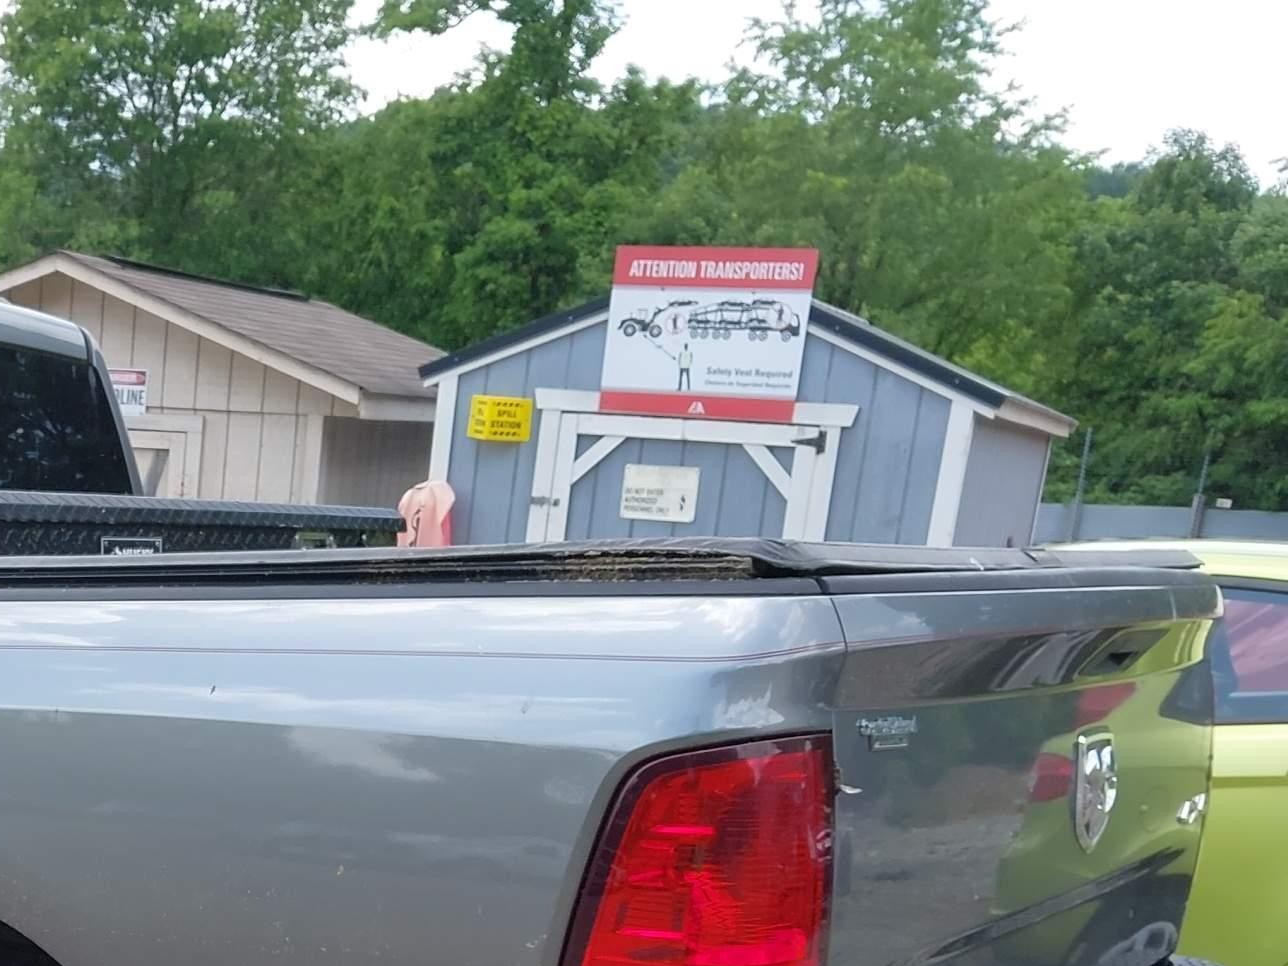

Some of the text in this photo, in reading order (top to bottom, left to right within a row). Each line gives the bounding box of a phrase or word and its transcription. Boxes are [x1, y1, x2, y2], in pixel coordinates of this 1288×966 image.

[628, 259, 805, 281] ATTENTION TRANSPORTERS!
[706, 366, 793, 379] Safety Vest Required
[497, 409, 517, 418] SPILL
[490, 420, 521, 429] STATION
